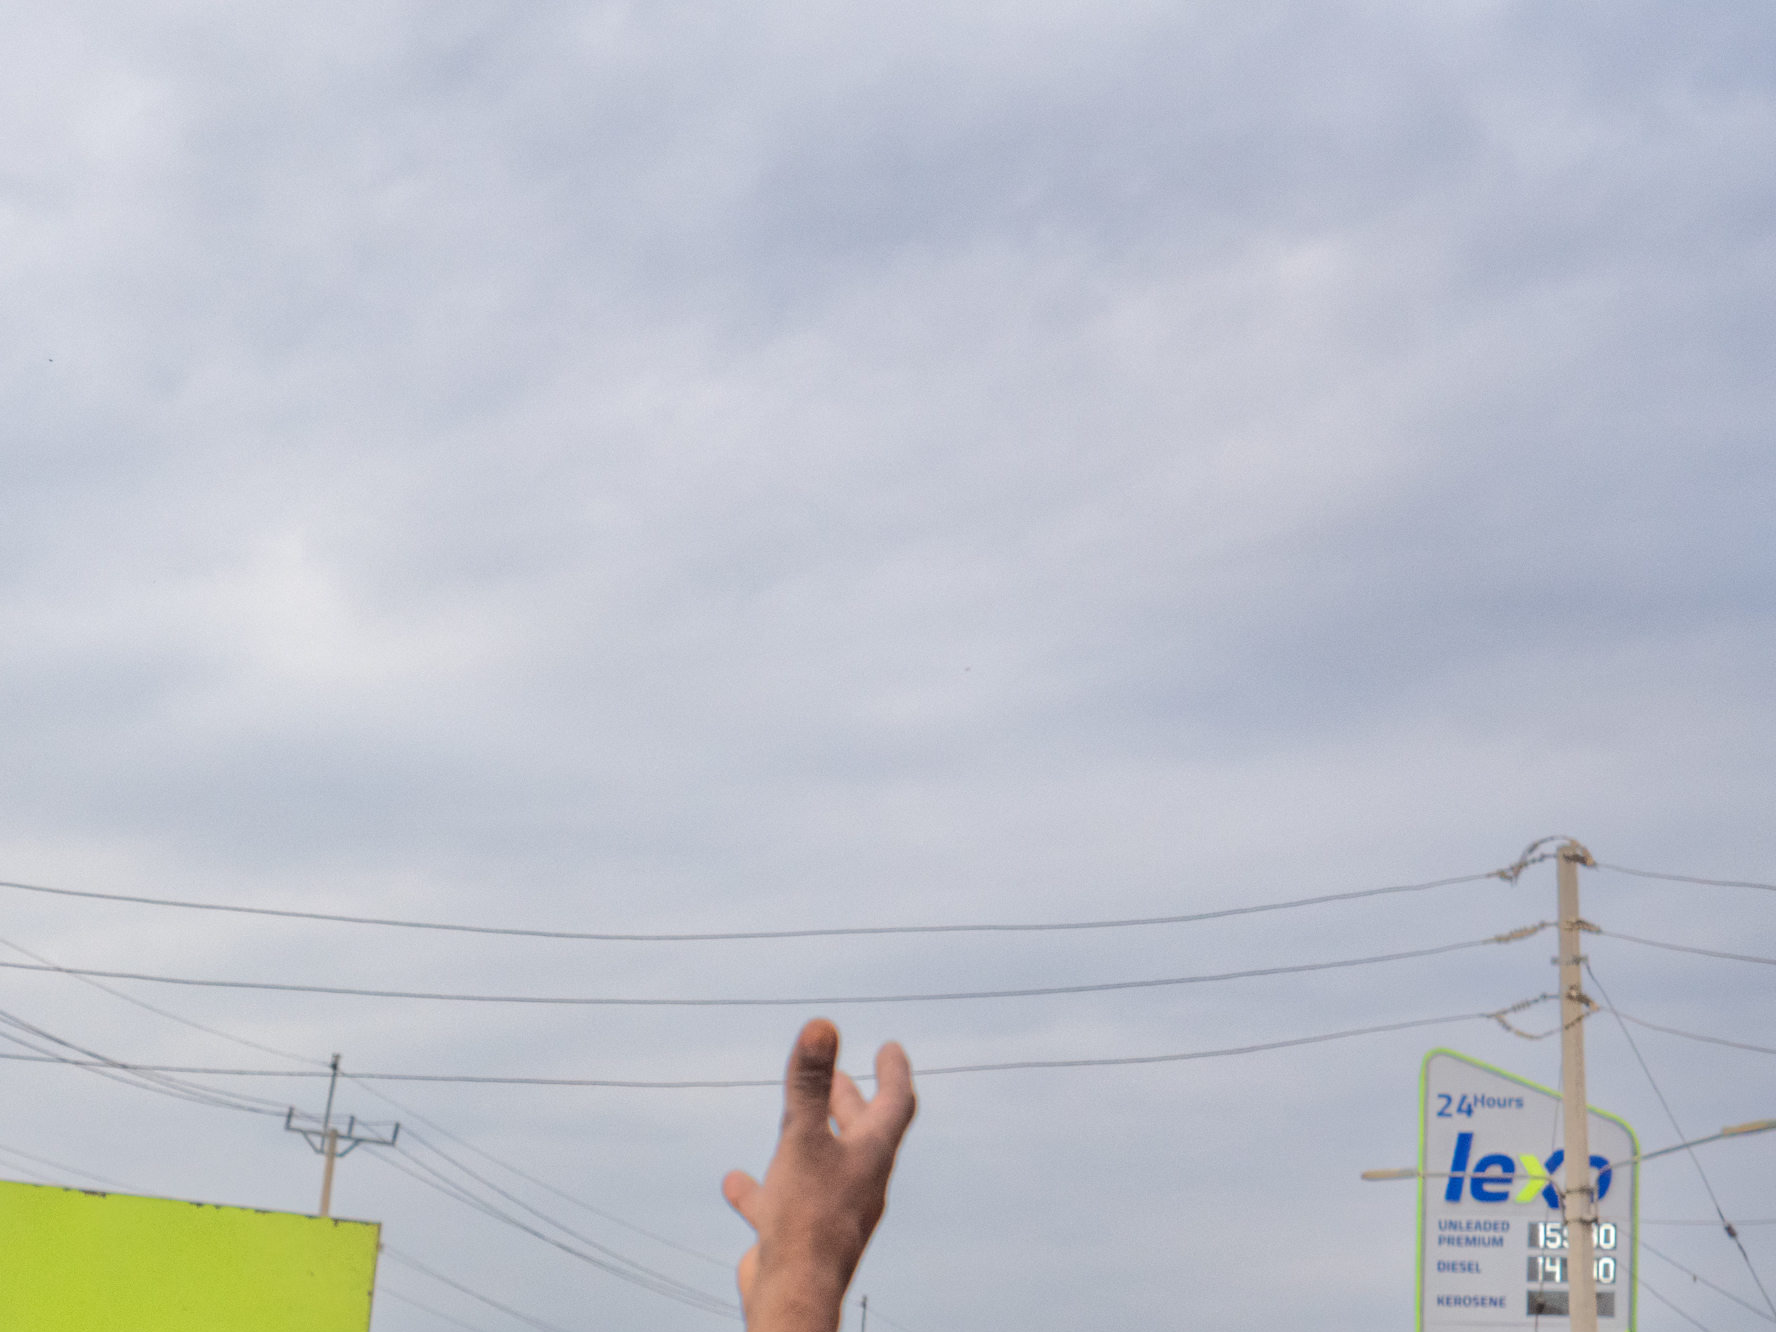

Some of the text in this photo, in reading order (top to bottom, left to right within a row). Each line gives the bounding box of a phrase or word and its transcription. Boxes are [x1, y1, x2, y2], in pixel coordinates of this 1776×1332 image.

[1438, 1219, 1510, 1232] UNLEADED
[1437, 1234, 1504, 1248] PREMIUM
[1436, 1260, 1481, 1274] DIESEL
[1436, 1295, 1507, 1309] KEROSENE
